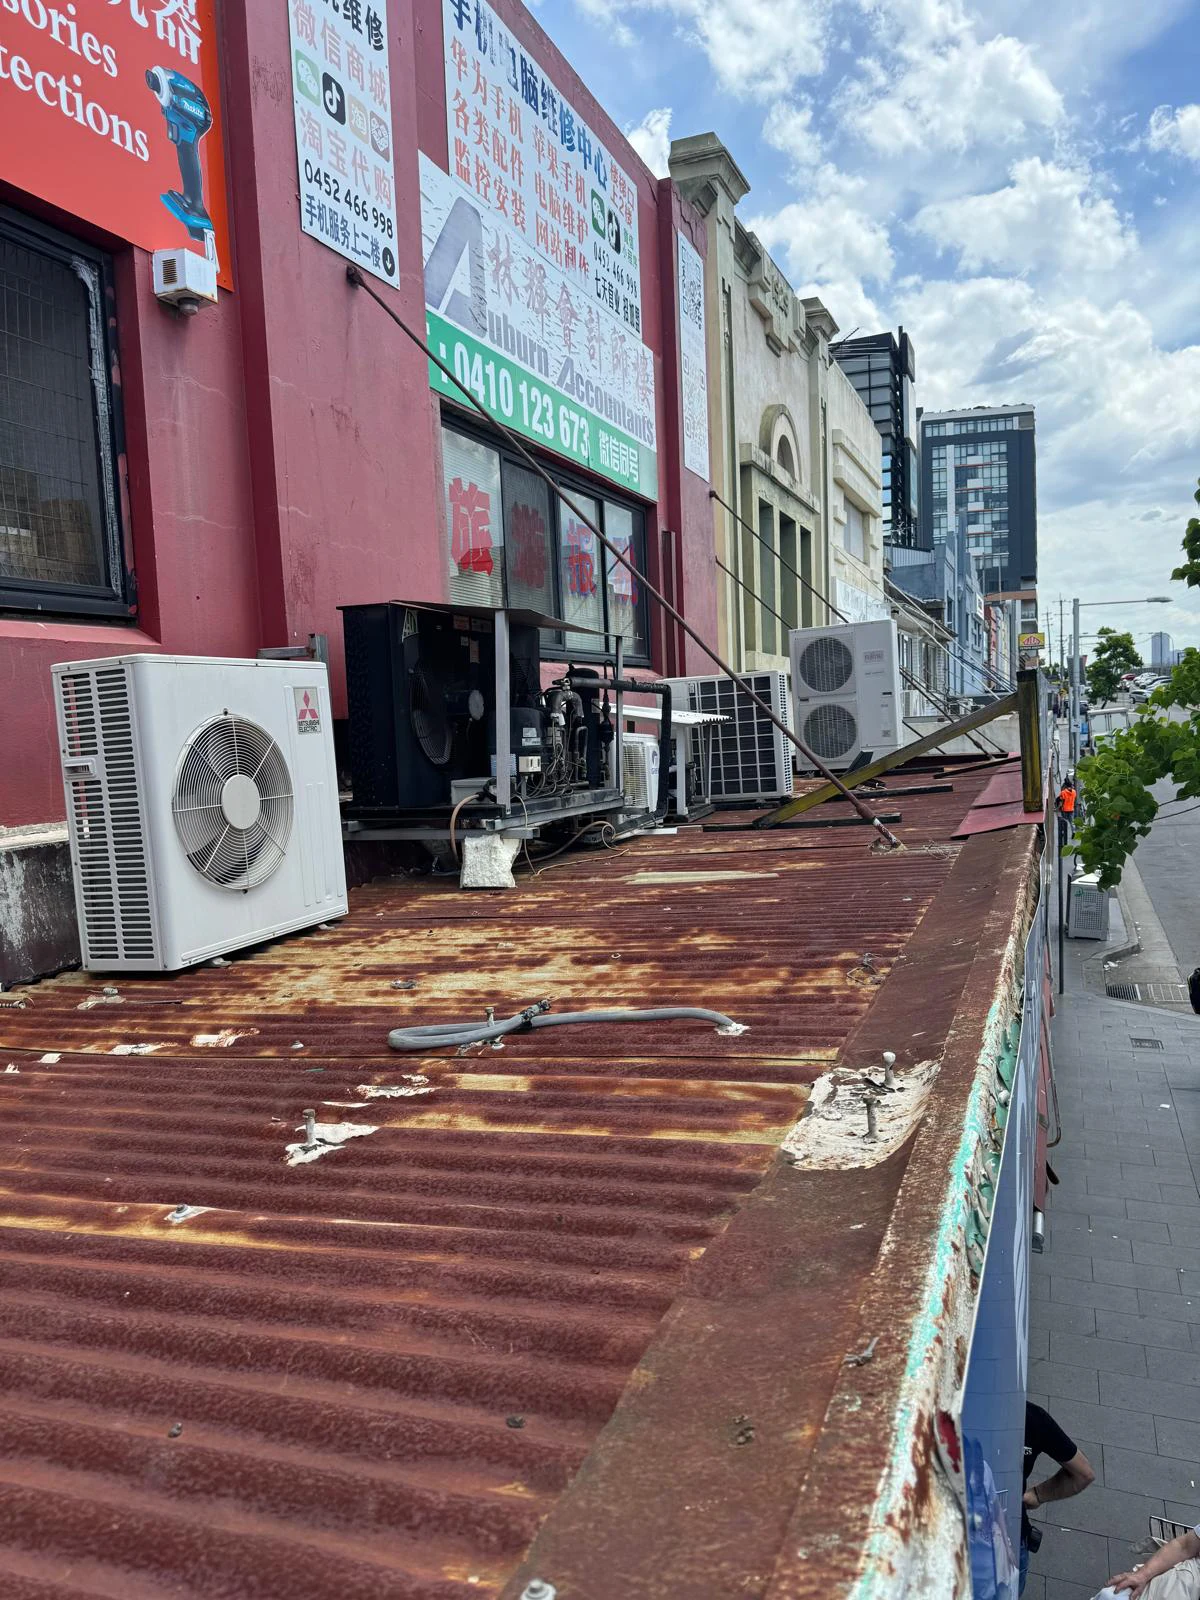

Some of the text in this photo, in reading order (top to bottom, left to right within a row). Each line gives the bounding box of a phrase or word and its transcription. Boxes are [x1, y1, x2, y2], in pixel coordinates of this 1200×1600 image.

[293, 0, 388, 112] 微信商城
[450, 36, 524, 144] 华为手机
[300, 104, 393, 210] 淘宝代购
[304, 158, 394, 240] 0452 466 998
[454, 137, 527, 236] 监控安装
[532, 124, 588, 210] 苹果手机
[305, 194, 382, 271] 手机服务上二楼
[534, 171, 589, 244] 电脑维护
[593, 241, 611, 272] 0452
[612, 262, 625, 286] 466
[594, 270, 621, 317] 七天营业
[424, 196, 551, 378] Auburn
[556, 355, 655, 448] Accountants
[453, 341, 514, 418] 0410
[519, 380, 555, 441] 123
[559, 405, 591, 459] 673
[598, 428, 640, 484] 微信同号
